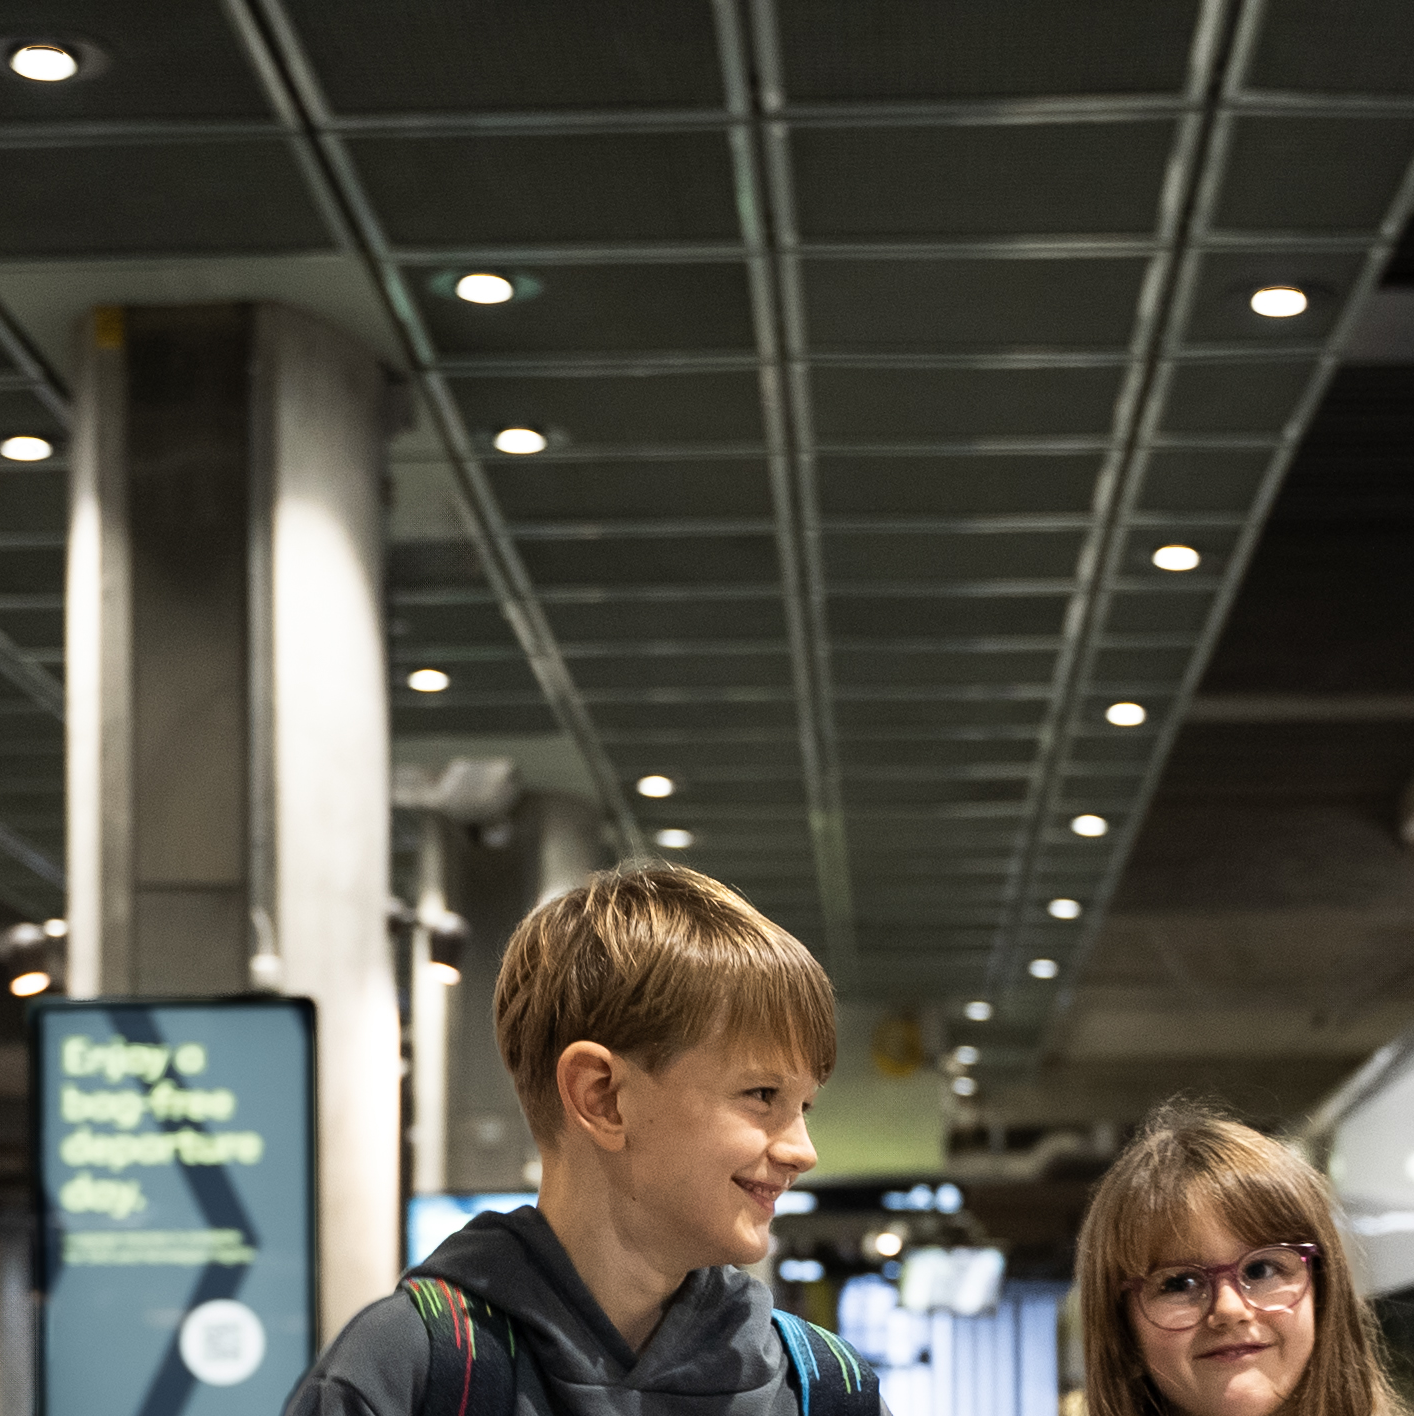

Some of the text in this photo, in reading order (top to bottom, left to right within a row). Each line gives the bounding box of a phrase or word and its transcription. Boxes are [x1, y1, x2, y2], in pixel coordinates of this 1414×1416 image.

[63, 1034, 206, 1084] Enjoy a
[60, 1125, 264, 1172] departure
